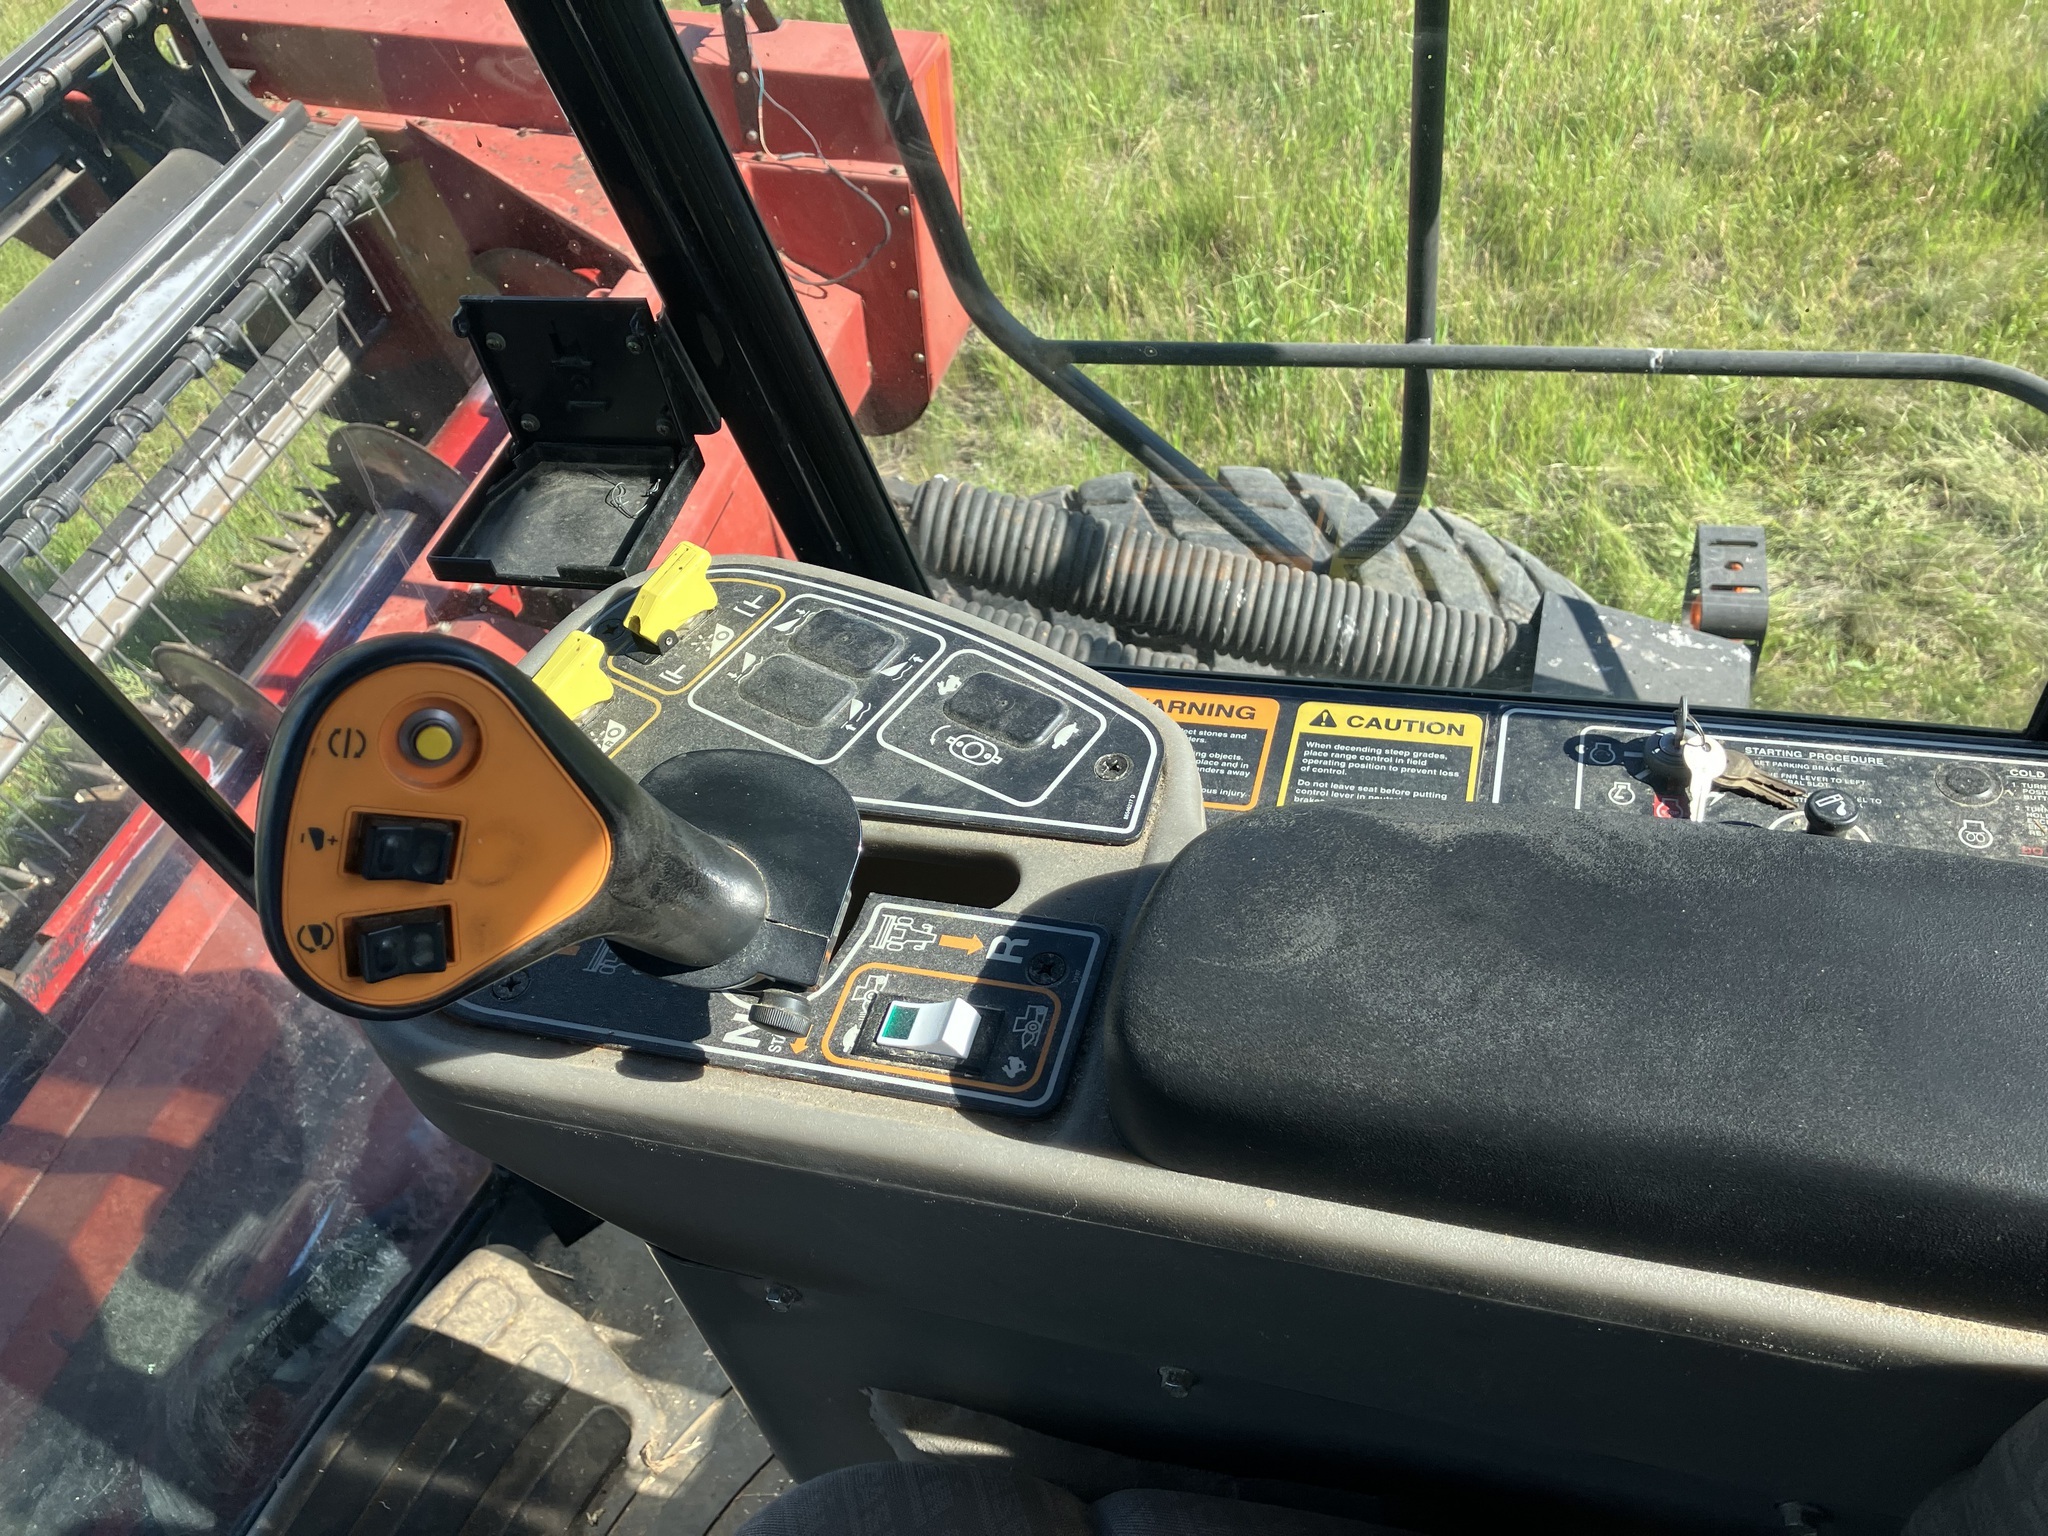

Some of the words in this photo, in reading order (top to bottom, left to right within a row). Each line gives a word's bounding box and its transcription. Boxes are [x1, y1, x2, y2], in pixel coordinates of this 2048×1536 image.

[1148, 698, 1256, 720] ARNING
[1347, 715, 1465, 737] CAUTION
[1199, 730, 1228, 738] stones
[1306, 741, 1332, 750] When
[1334, 744, 1383, 755] decending
[1385, 748, 1410, 757] steep
[1209, 751, 1244, 761] objects.
[1304, 749, 1329, 757] place
[1331, 752, 1357, 760] range
[1360, 754, 1393, 763] control
[1395, 756, 1404, 764] in
[1407, 757, 1427, 766] field
[1745, 746, 1803, 758] STARTING
[1809, 751, 1885, 765] PROCEDURE
[1221, 761, 1239, 769] and
[1302, 758, 1346, 768] operating
[1348, 760, 1386, 770] position
[1389, 764, 1399, 772] to
[1401, 766, 1438, 775] prevent
[1439, 769, 1460, 778] loss
[1312, 766, 1347, 776] control.
[1772, 761, 1810, 770] PARKING
[1227, 769, 1251, 778] away
[1800, 774, 1828, 782] LEVER
[2009, 769, 2046, 778] COLD
[1296, 788, 1329, 797] control
[1331, 791, 1355, 799] lever
[1357, 792, 1366, 800] in
[1297, 779, 1311, 787] Do
[1313, 780, 1329, 789] not
[1330, 782, 1356, 791] leave
[1357, 784, 1378, 793] seat
[1380, 786, 1411, 796] before
[1413, 791, 1448, 801] putting
[986, 935, 1030, 964] R
